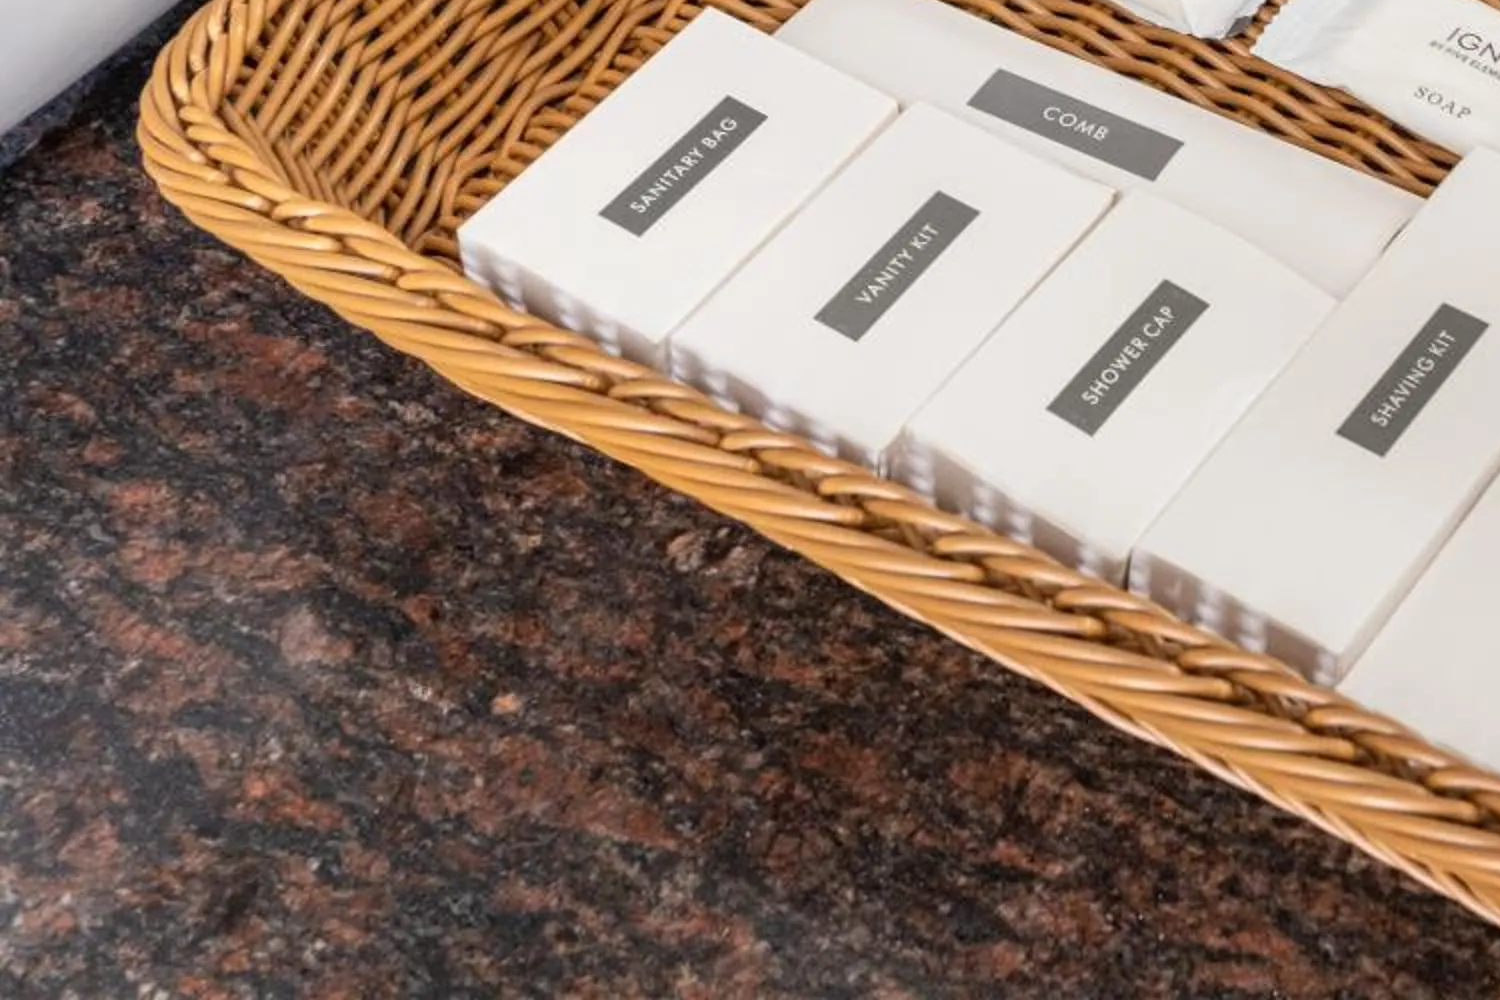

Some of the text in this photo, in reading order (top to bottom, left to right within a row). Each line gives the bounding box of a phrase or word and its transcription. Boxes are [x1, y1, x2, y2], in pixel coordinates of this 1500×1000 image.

[1043, 107, 1109, 141] COMB
[1414, 86, 1471, 118] SOAP
[630, 117, 737, 214] SANITARY BAG
[854, 223, 939, 303] VANITY KIT
[1081, 306, 1175, 405] SHOWER CAP
[1370, 329, 1456, 427] SHAVING KIT
